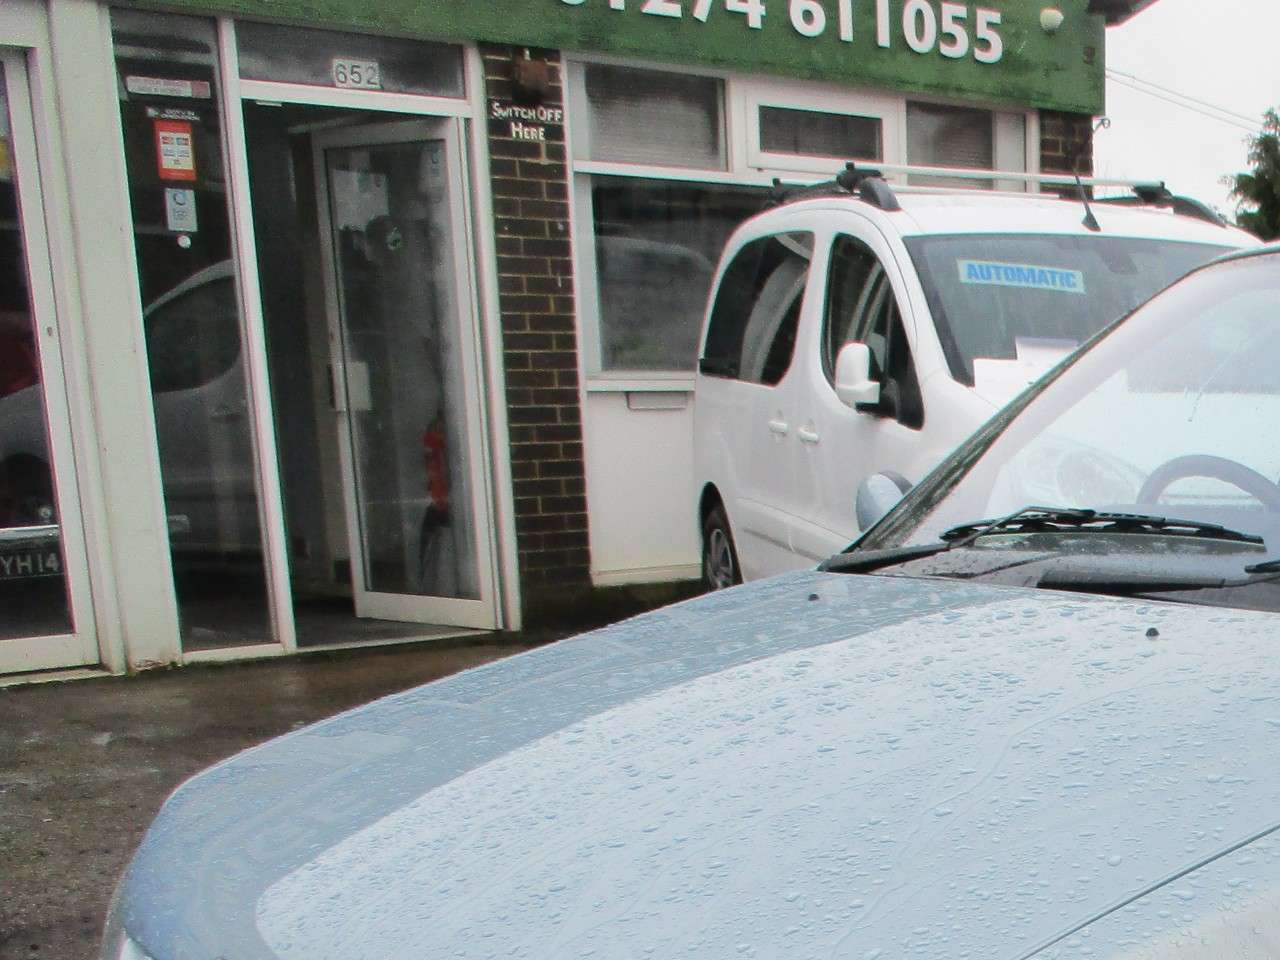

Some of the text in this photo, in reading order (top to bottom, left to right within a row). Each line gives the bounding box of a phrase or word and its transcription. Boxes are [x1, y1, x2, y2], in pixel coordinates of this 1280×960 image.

[788, 0, 1004, 64] 611055
[334, 61, 381, 86] 652
[537, 105, 562, 122] OFF
[512, 122, 546, 141] HERE
[967, 262, 1077, 289] AUTOMATIC
